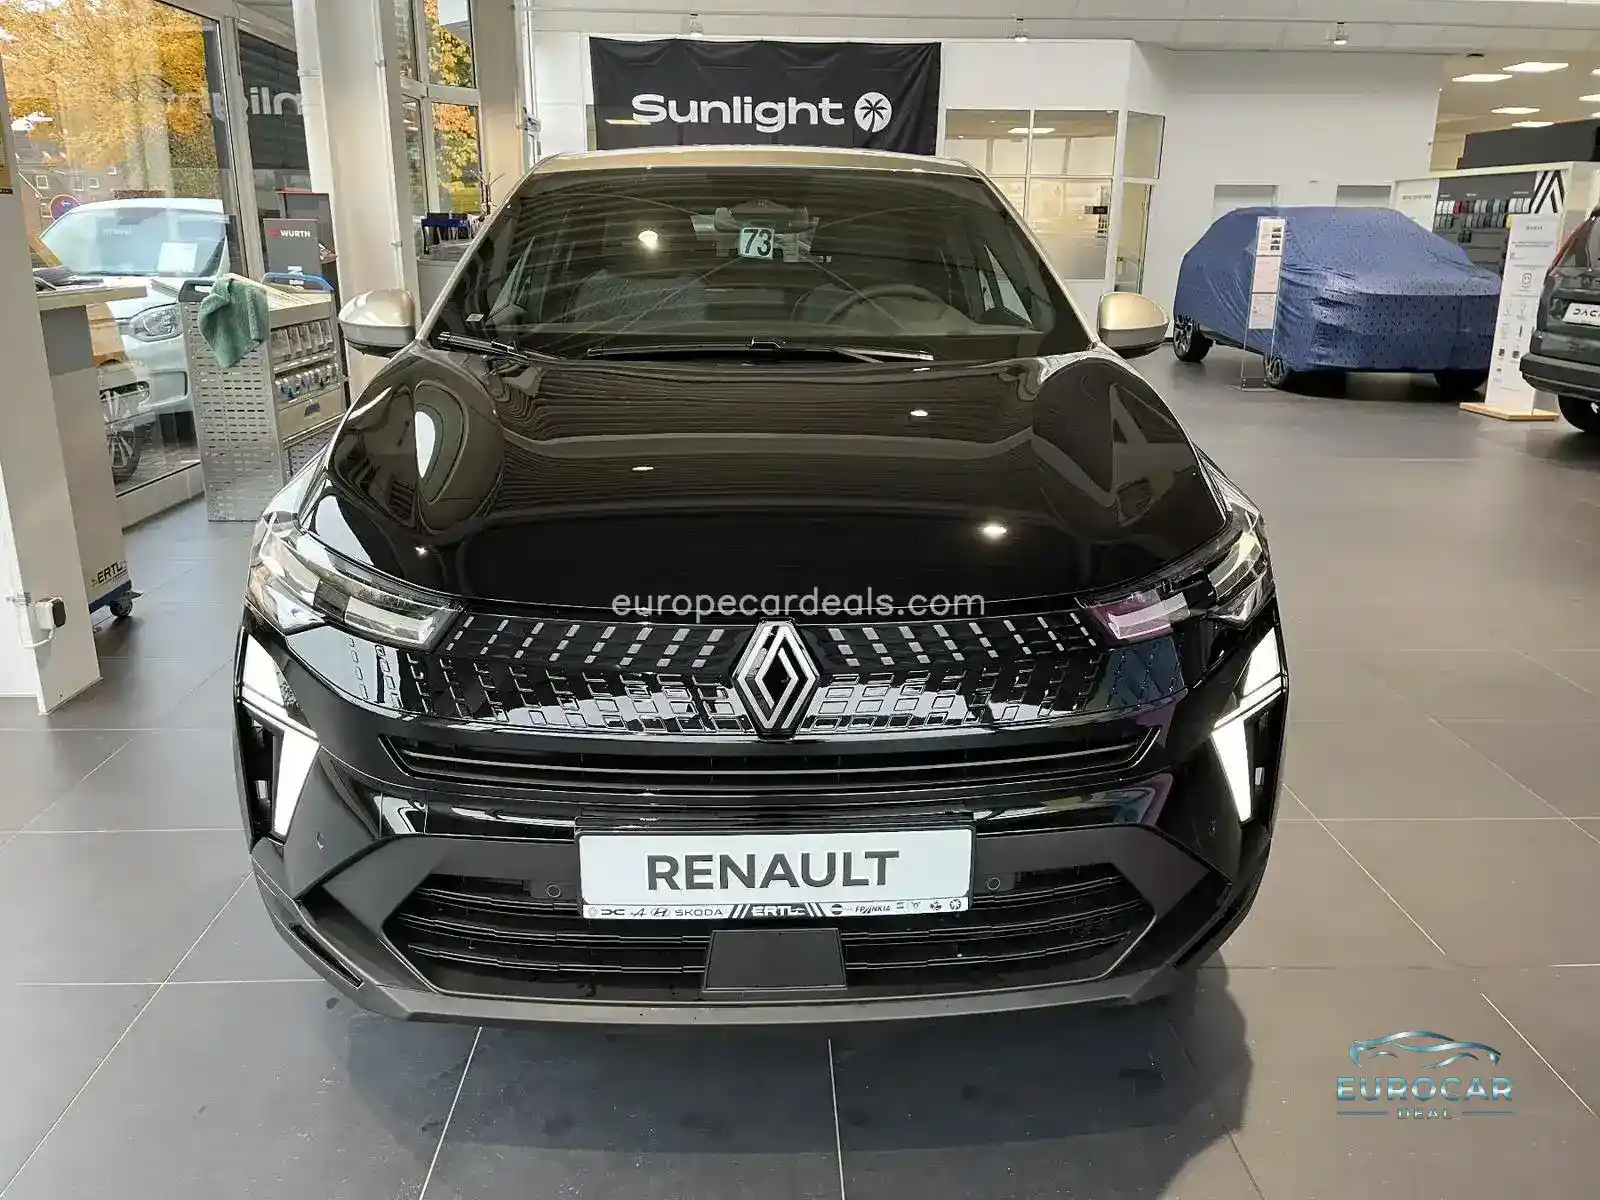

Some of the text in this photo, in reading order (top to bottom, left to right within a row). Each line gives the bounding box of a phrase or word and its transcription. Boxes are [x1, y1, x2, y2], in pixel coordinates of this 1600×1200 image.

[632, 93, 845, 133] Sunlight
[743, 228, 773, 257] 73
[97, 561, 123, 584] ERTL
[647, 850, 900, 891] RENAULT
[752, 905, 796, 917] ERTL
